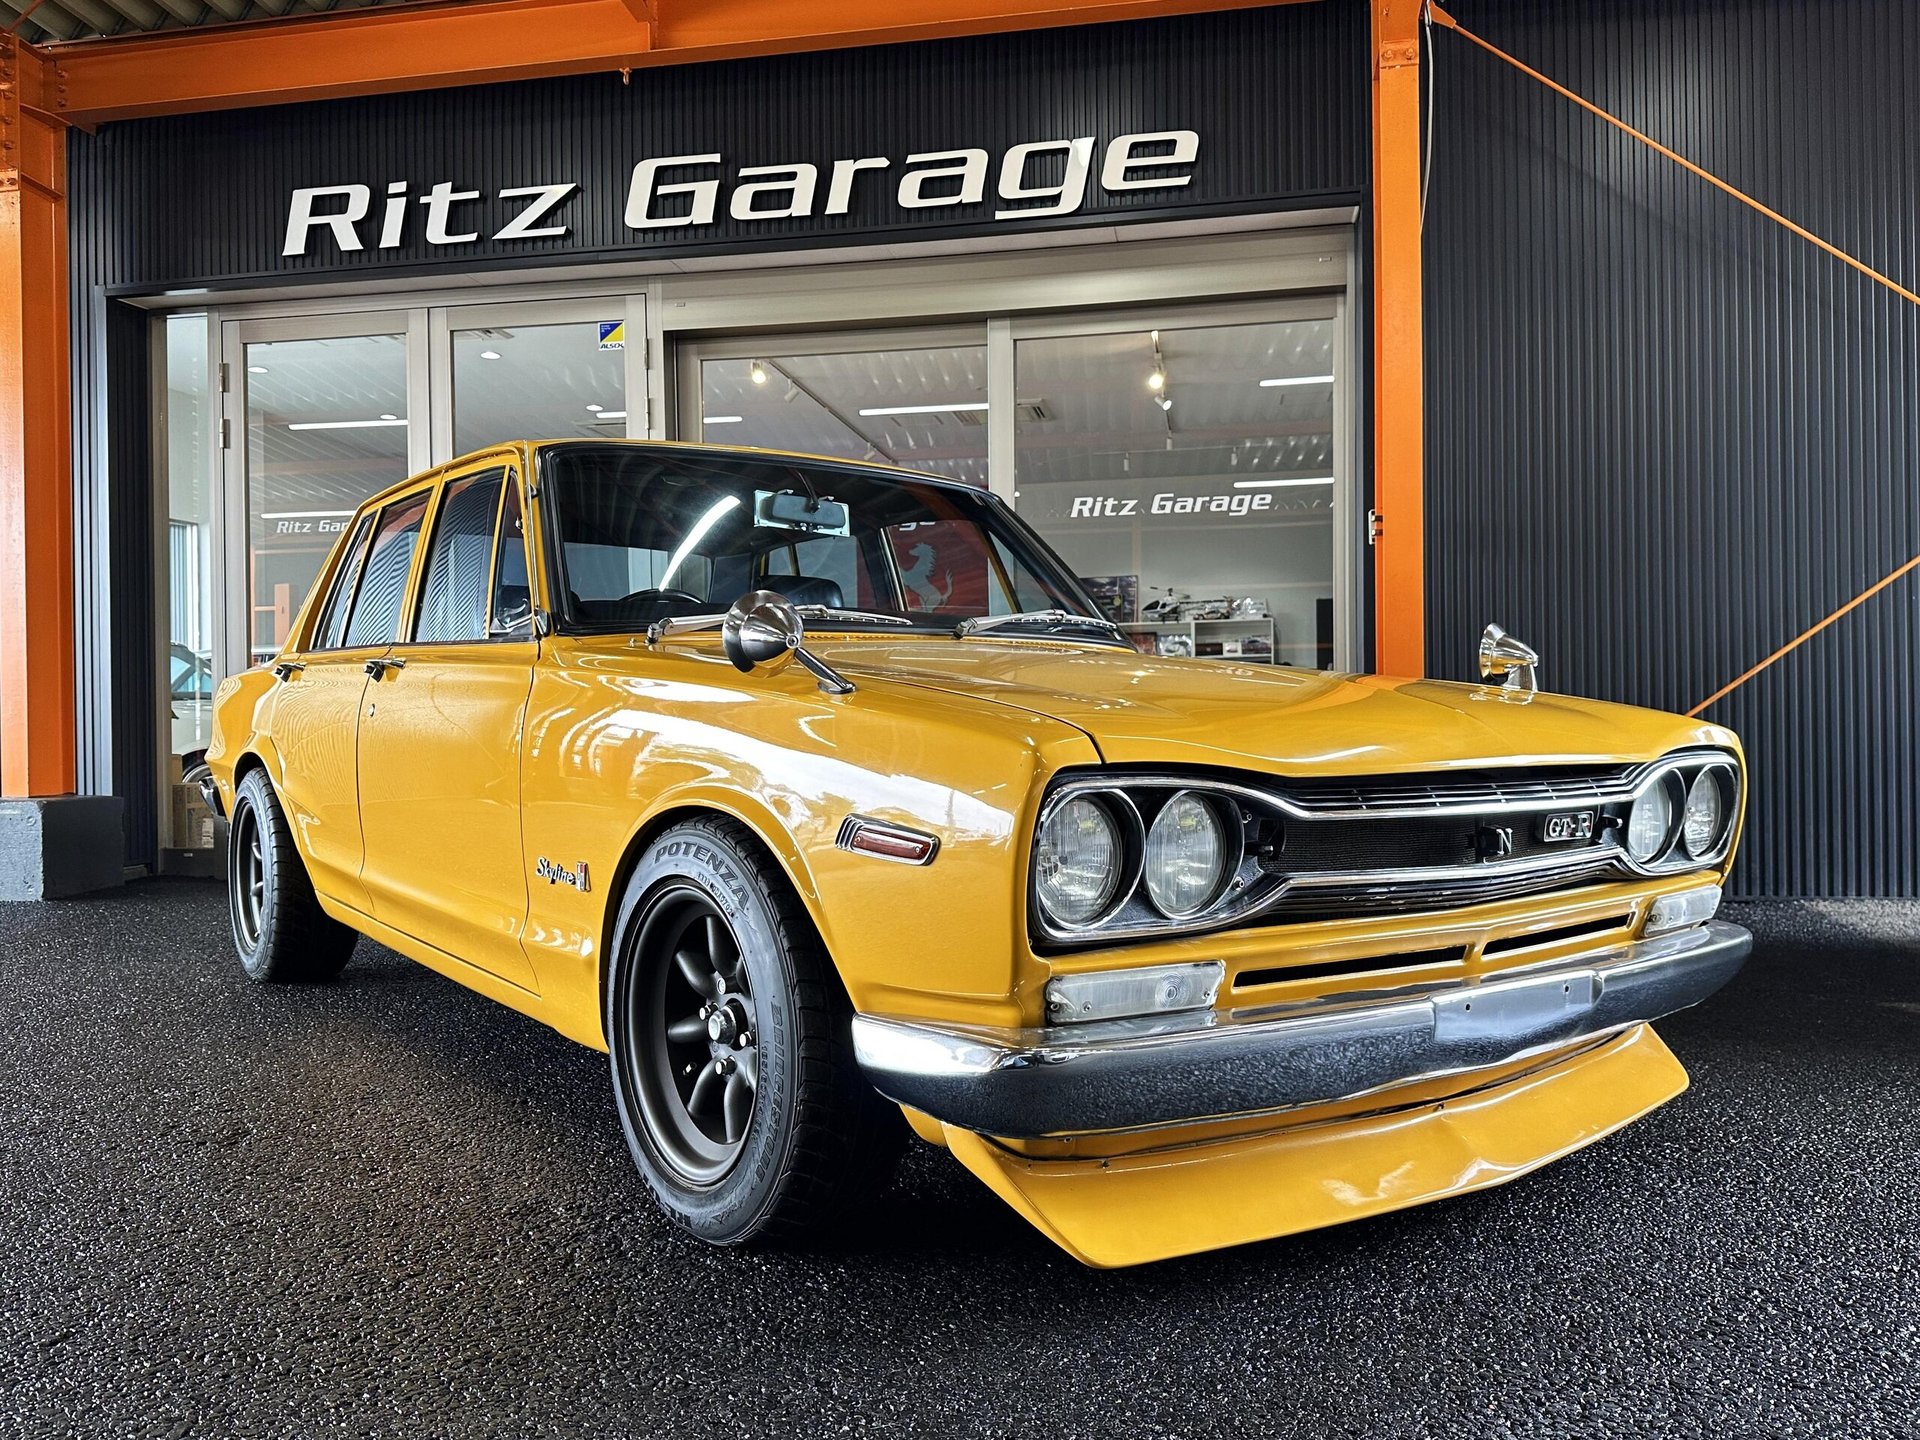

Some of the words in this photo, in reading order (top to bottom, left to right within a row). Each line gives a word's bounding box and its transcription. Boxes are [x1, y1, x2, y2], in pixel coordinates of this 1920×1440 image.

[282, 180, 577, 256] Ritz
[624, 130, 1200, 229] Garage
[1070, 496, 1138, 518] Ritz
[1150, 493, 1273, 517] Garage
[276, 520, 312, 534] Ritz
[1549, 813, 1592, 838] GT-R
[536, 856, 576, 885] Skyline
[654, 841, 750, 912] POTENZA
[755, 1001, 785, 1183] BRIDGESTONE
